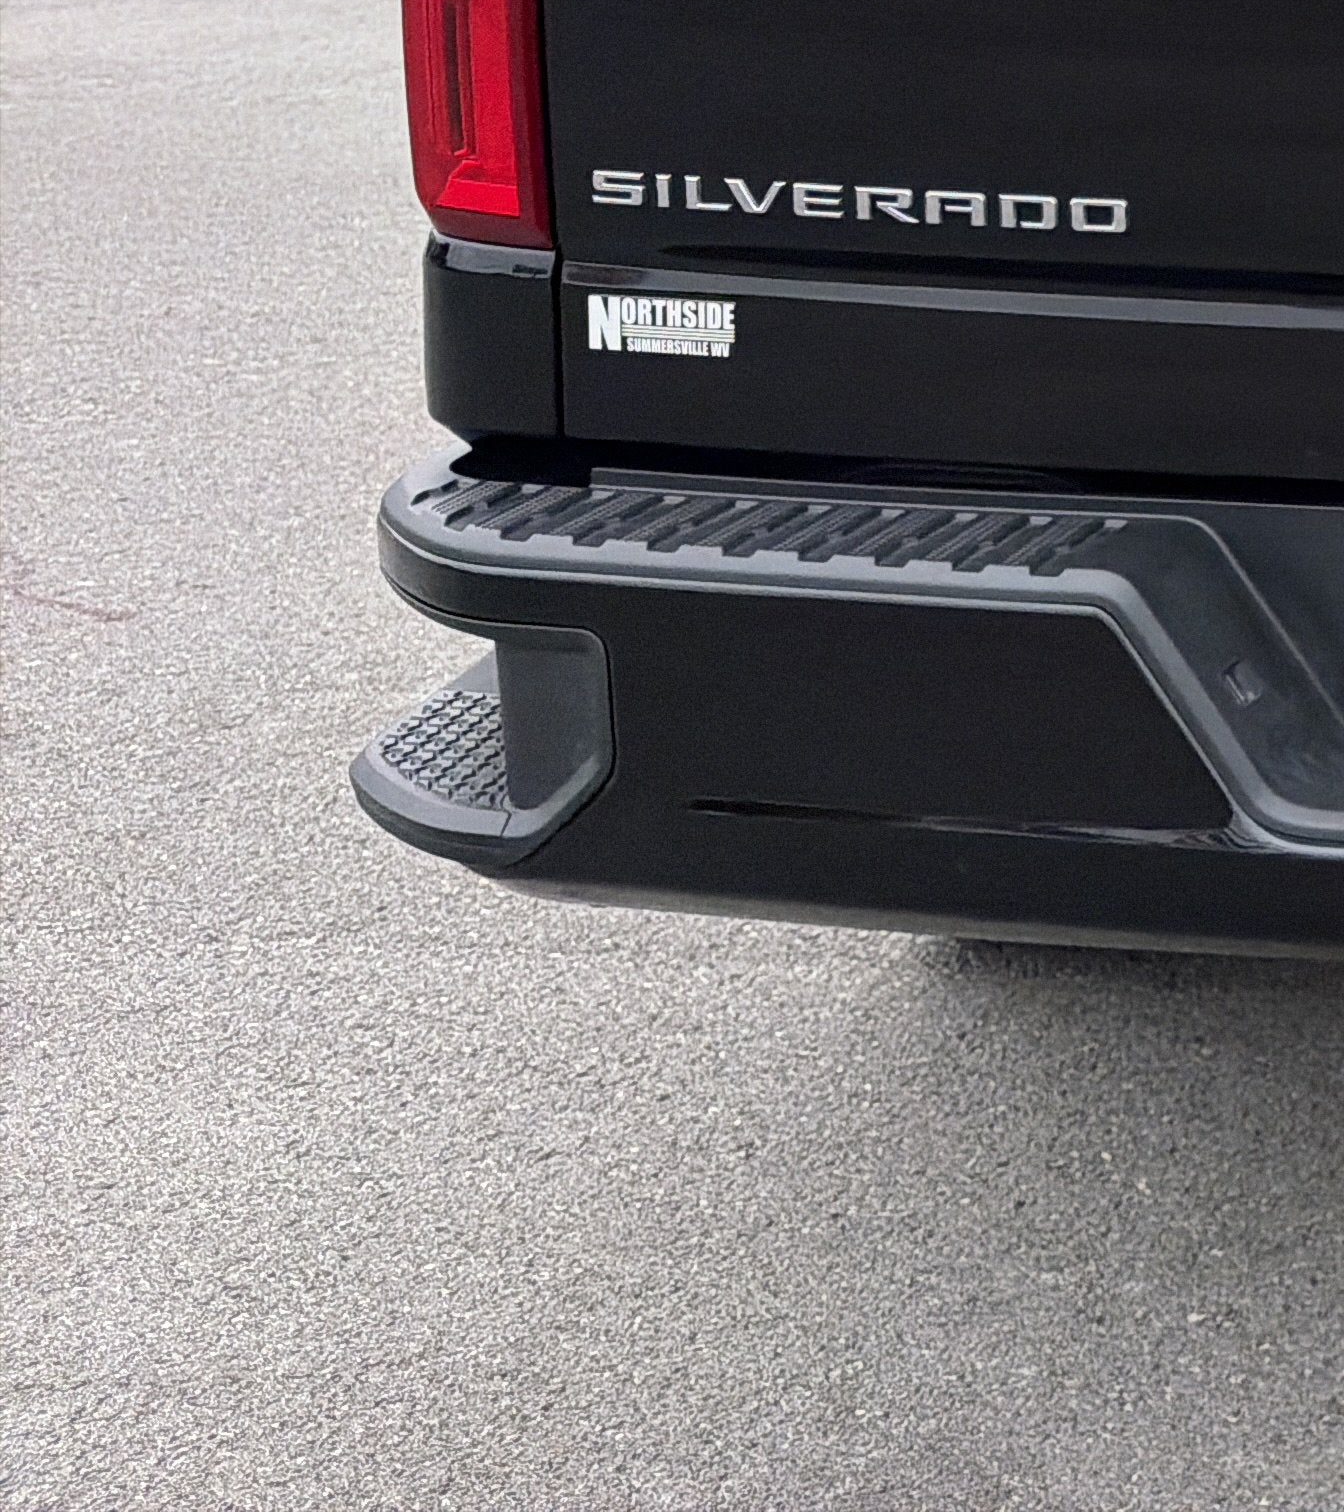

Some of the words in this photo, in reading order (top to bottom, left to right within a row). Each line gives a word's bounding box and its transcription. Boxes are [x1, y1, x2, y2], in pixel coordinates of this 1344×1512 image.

[591, 169, 1130, 234] SILVERADO
[587, 294, 737, 352] NORTHSIDE
[626, 338, 709, 357] SUMMERSVILLE
[710, 343, 730, 358] WV
